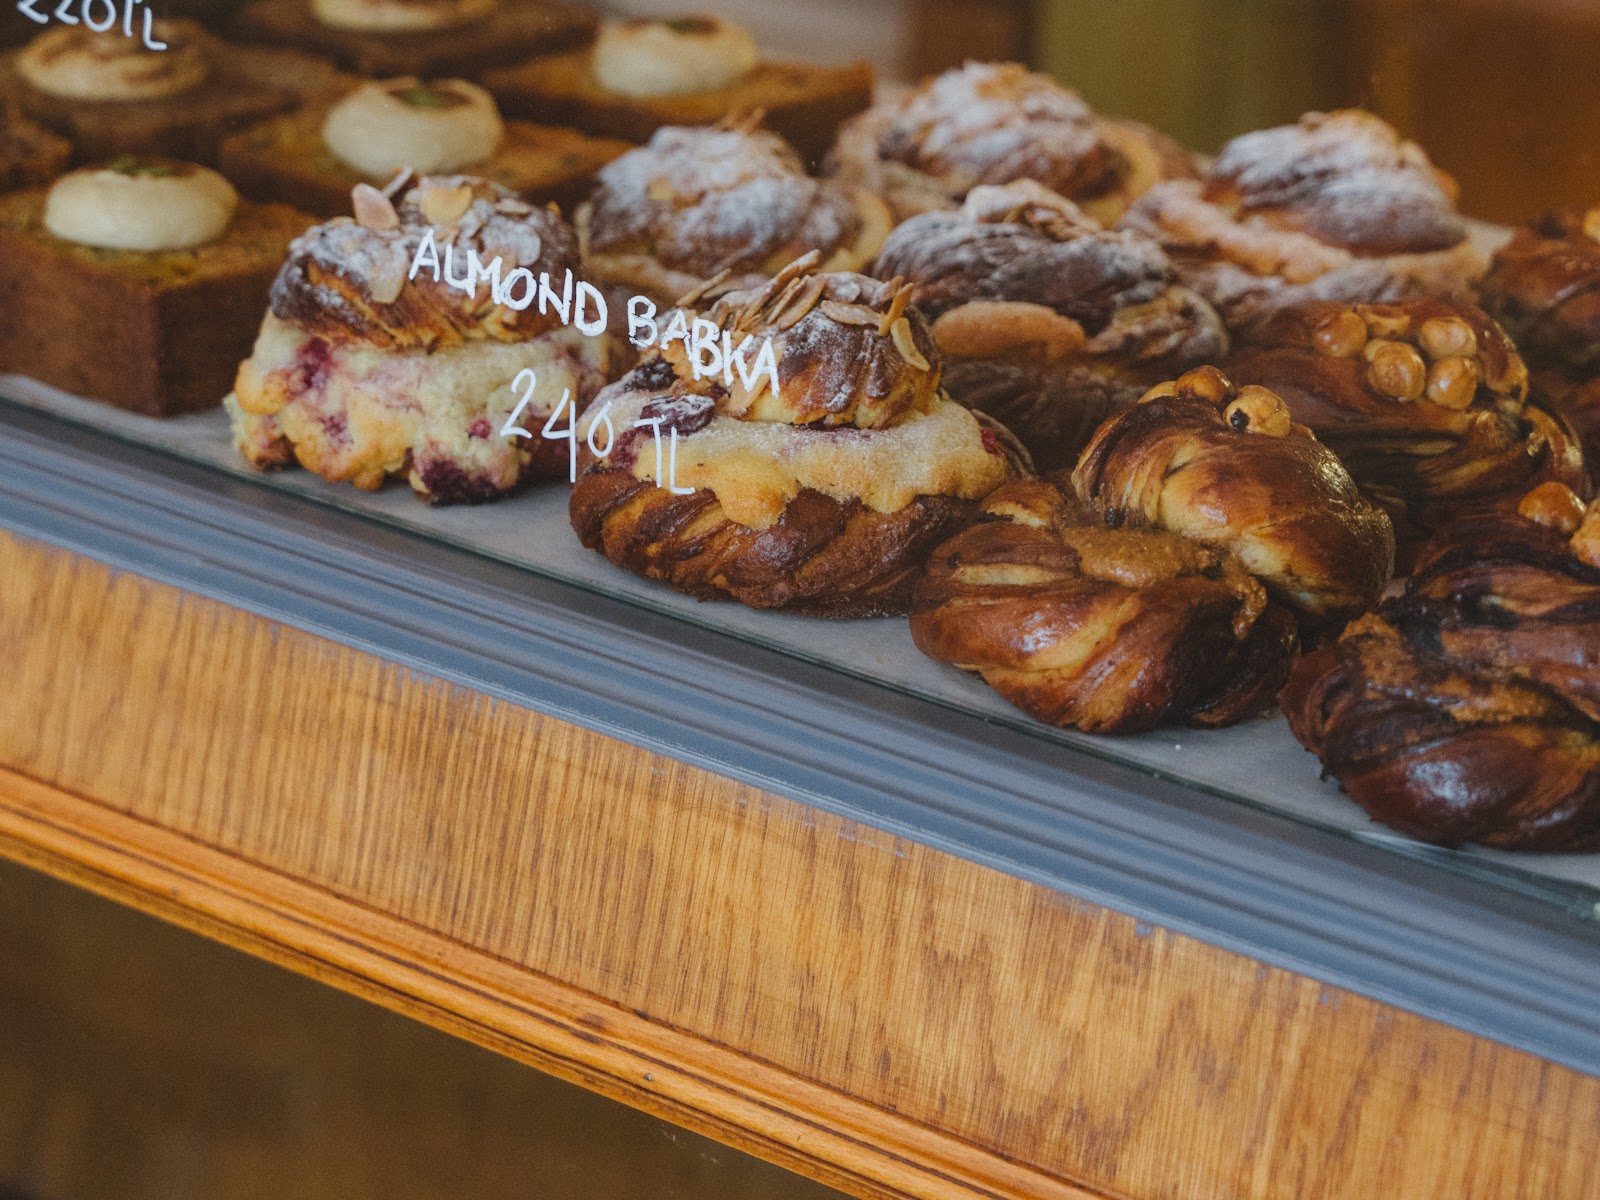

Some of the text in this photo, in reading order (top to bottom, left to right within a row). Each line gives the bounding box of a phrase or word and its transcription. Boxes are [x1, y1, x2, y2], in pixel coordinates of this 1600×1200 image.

[408, 227, 780, 399] ALMOND BABKA
[499, 367, 697, 496] 240 TL
